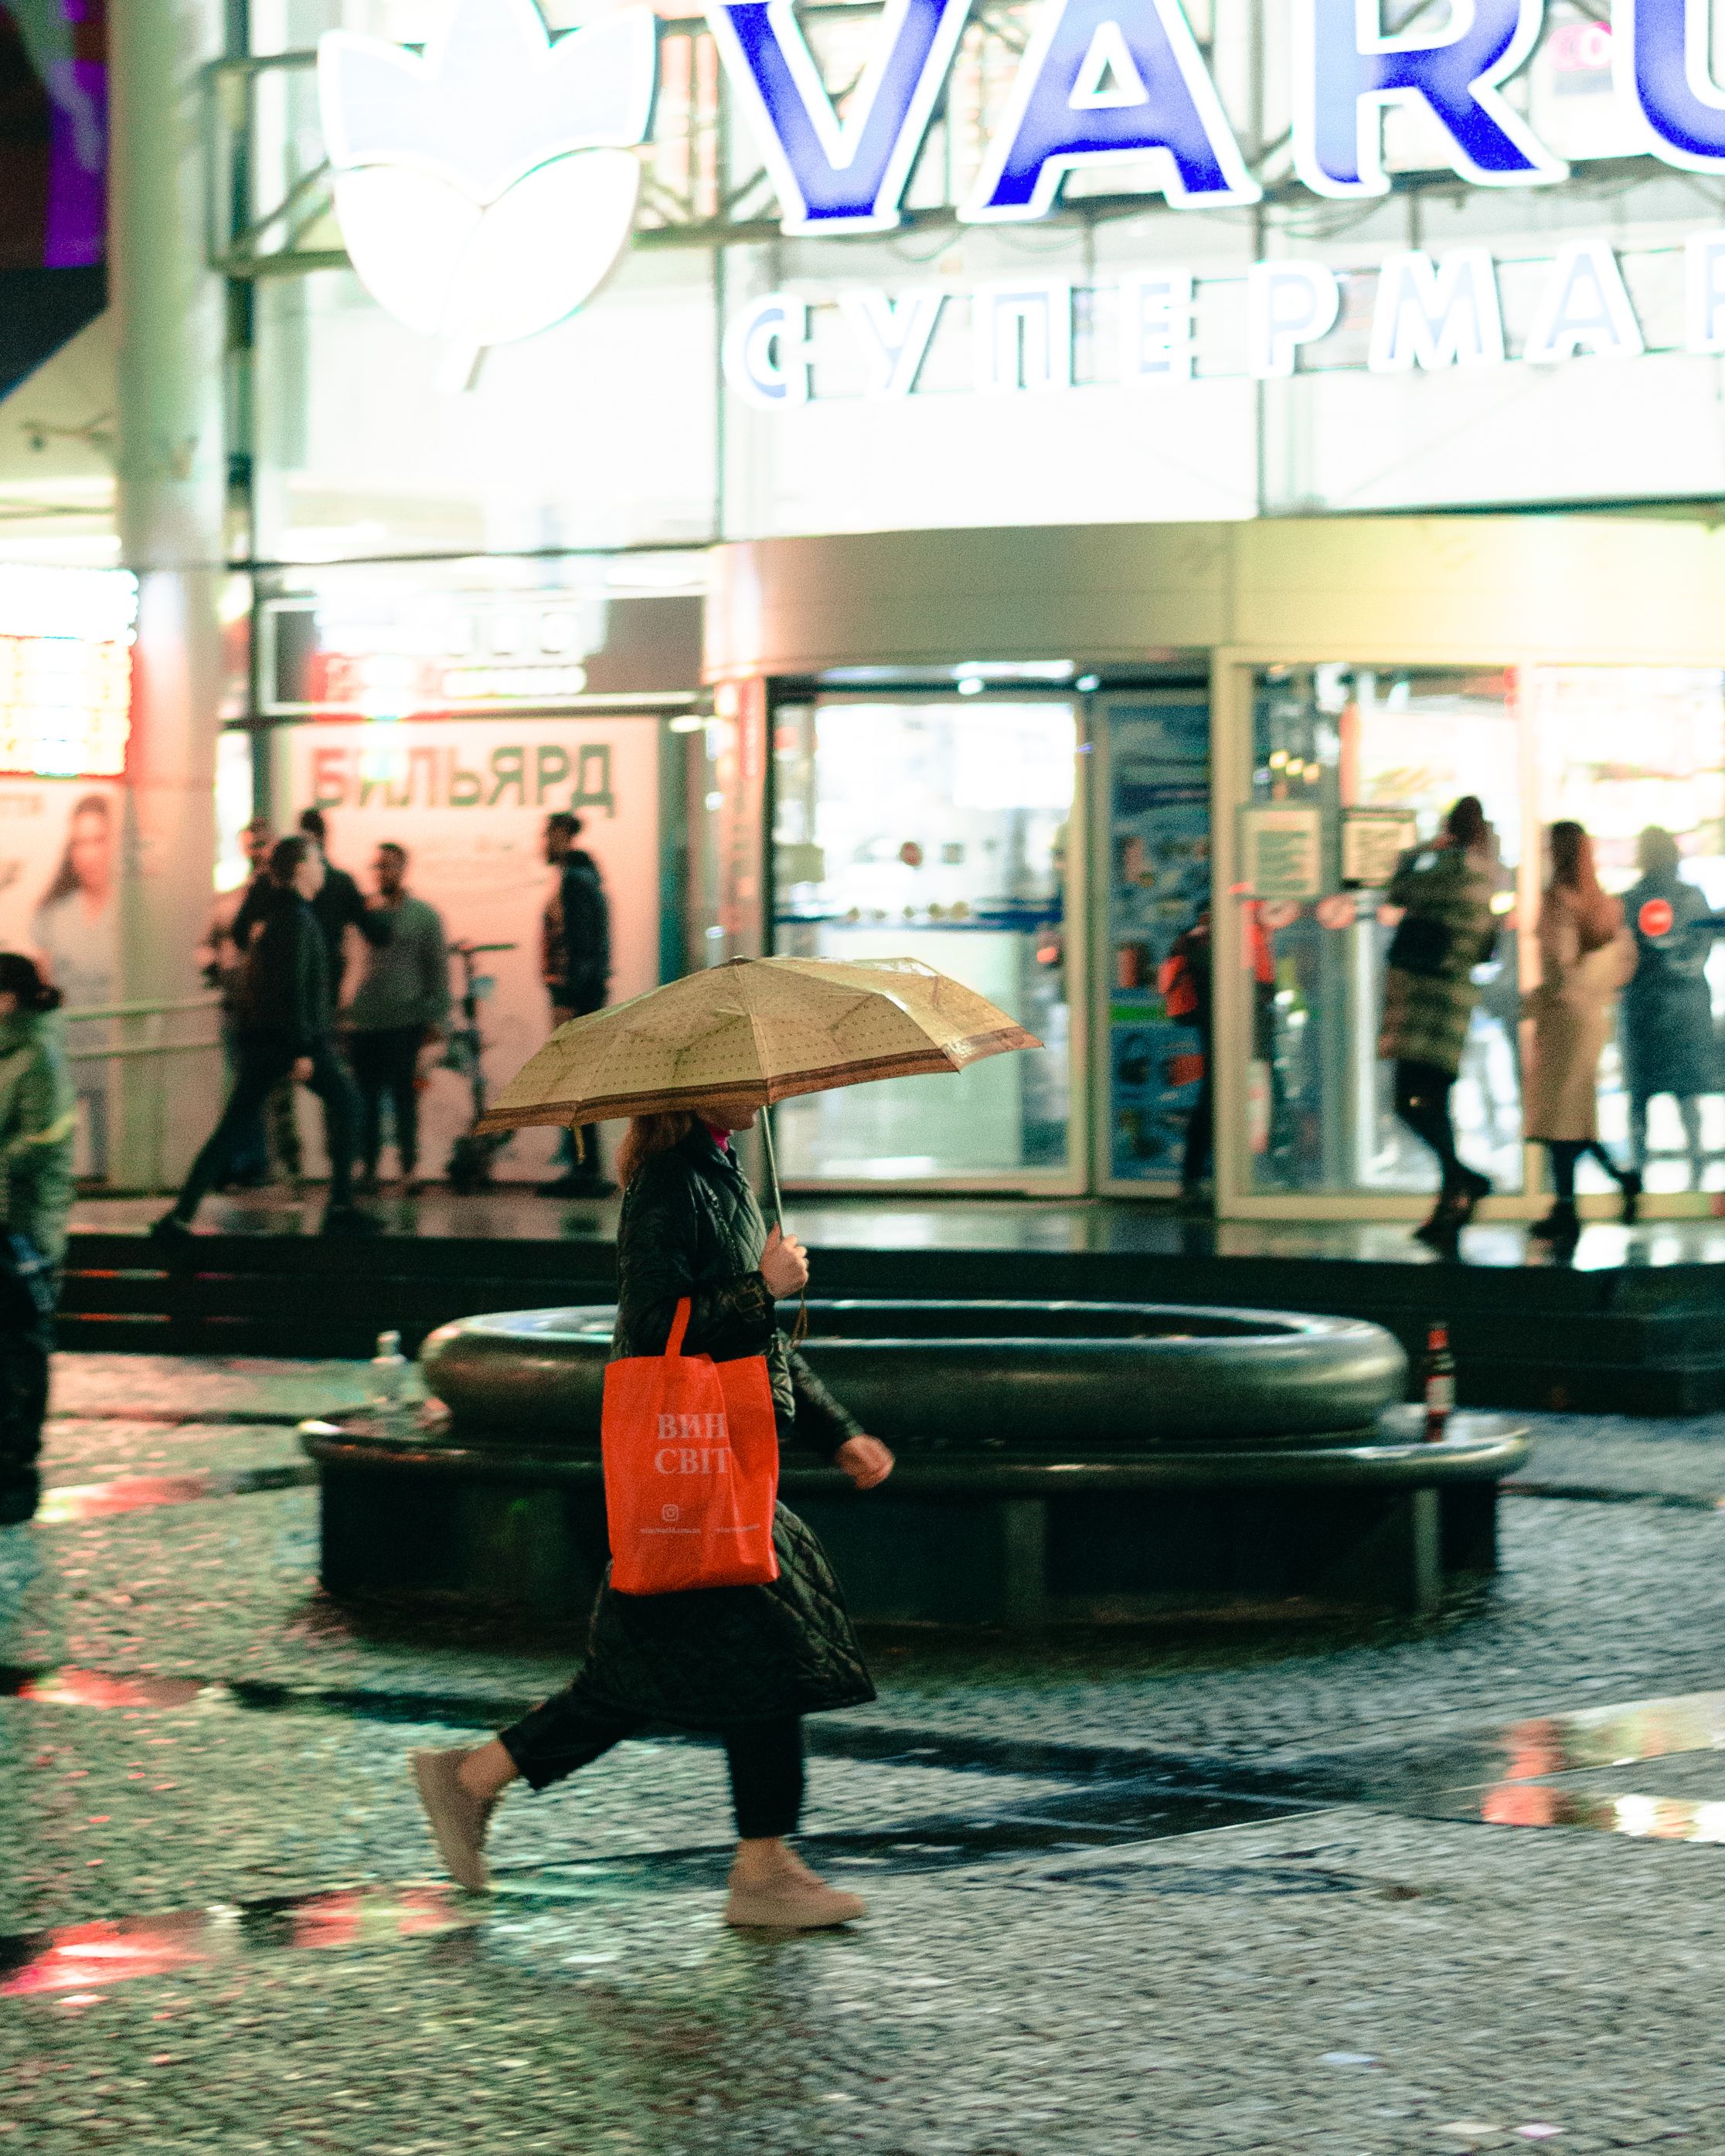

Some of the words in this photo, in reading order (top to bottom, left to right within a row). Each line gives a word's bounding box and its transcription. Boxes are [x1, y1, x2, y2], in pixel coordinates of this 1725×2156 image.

[312, 744, 617, 818] БИЛЬЯРД
[657, 1413, 730, 1440] ВИН
[655, 1447, 731, 1475] СВІТ
